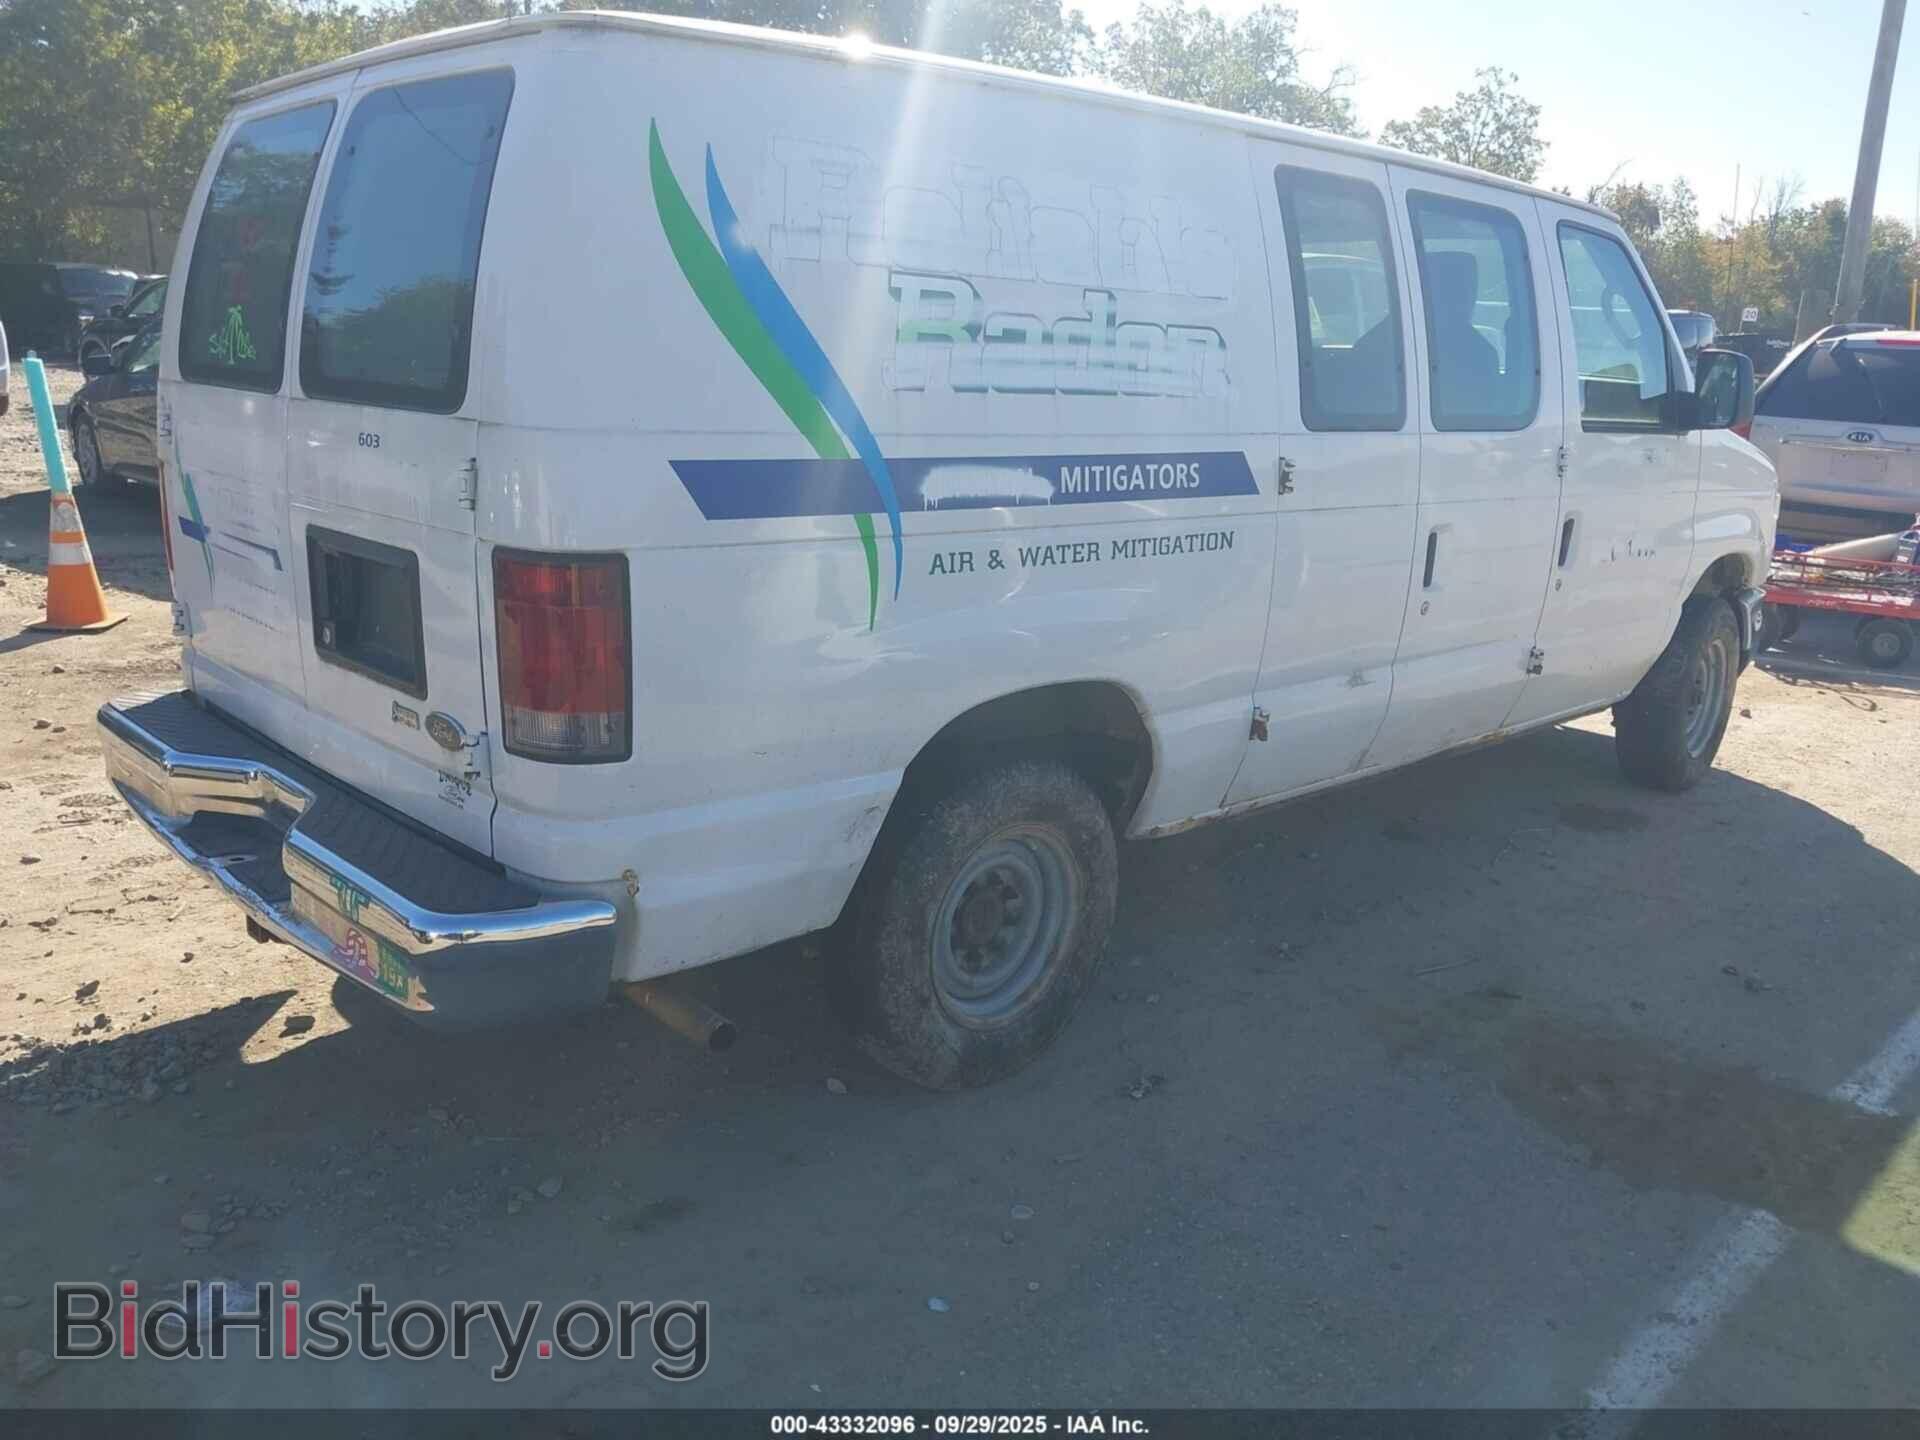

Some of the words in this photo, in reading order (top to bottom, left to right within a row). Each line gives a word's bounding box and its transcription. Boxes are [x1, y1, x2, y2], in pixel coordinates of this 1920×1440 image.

[358, 432, 380, 448] 603
[1060, 463, 1200, 494] MITIGATORS
[929, 551, 975, 575] AIR
[988, 549, 1006, 570] &
[1018, 541, 1101, 568] WATER
[1111, 530, 1236, 560] MITIGATION
